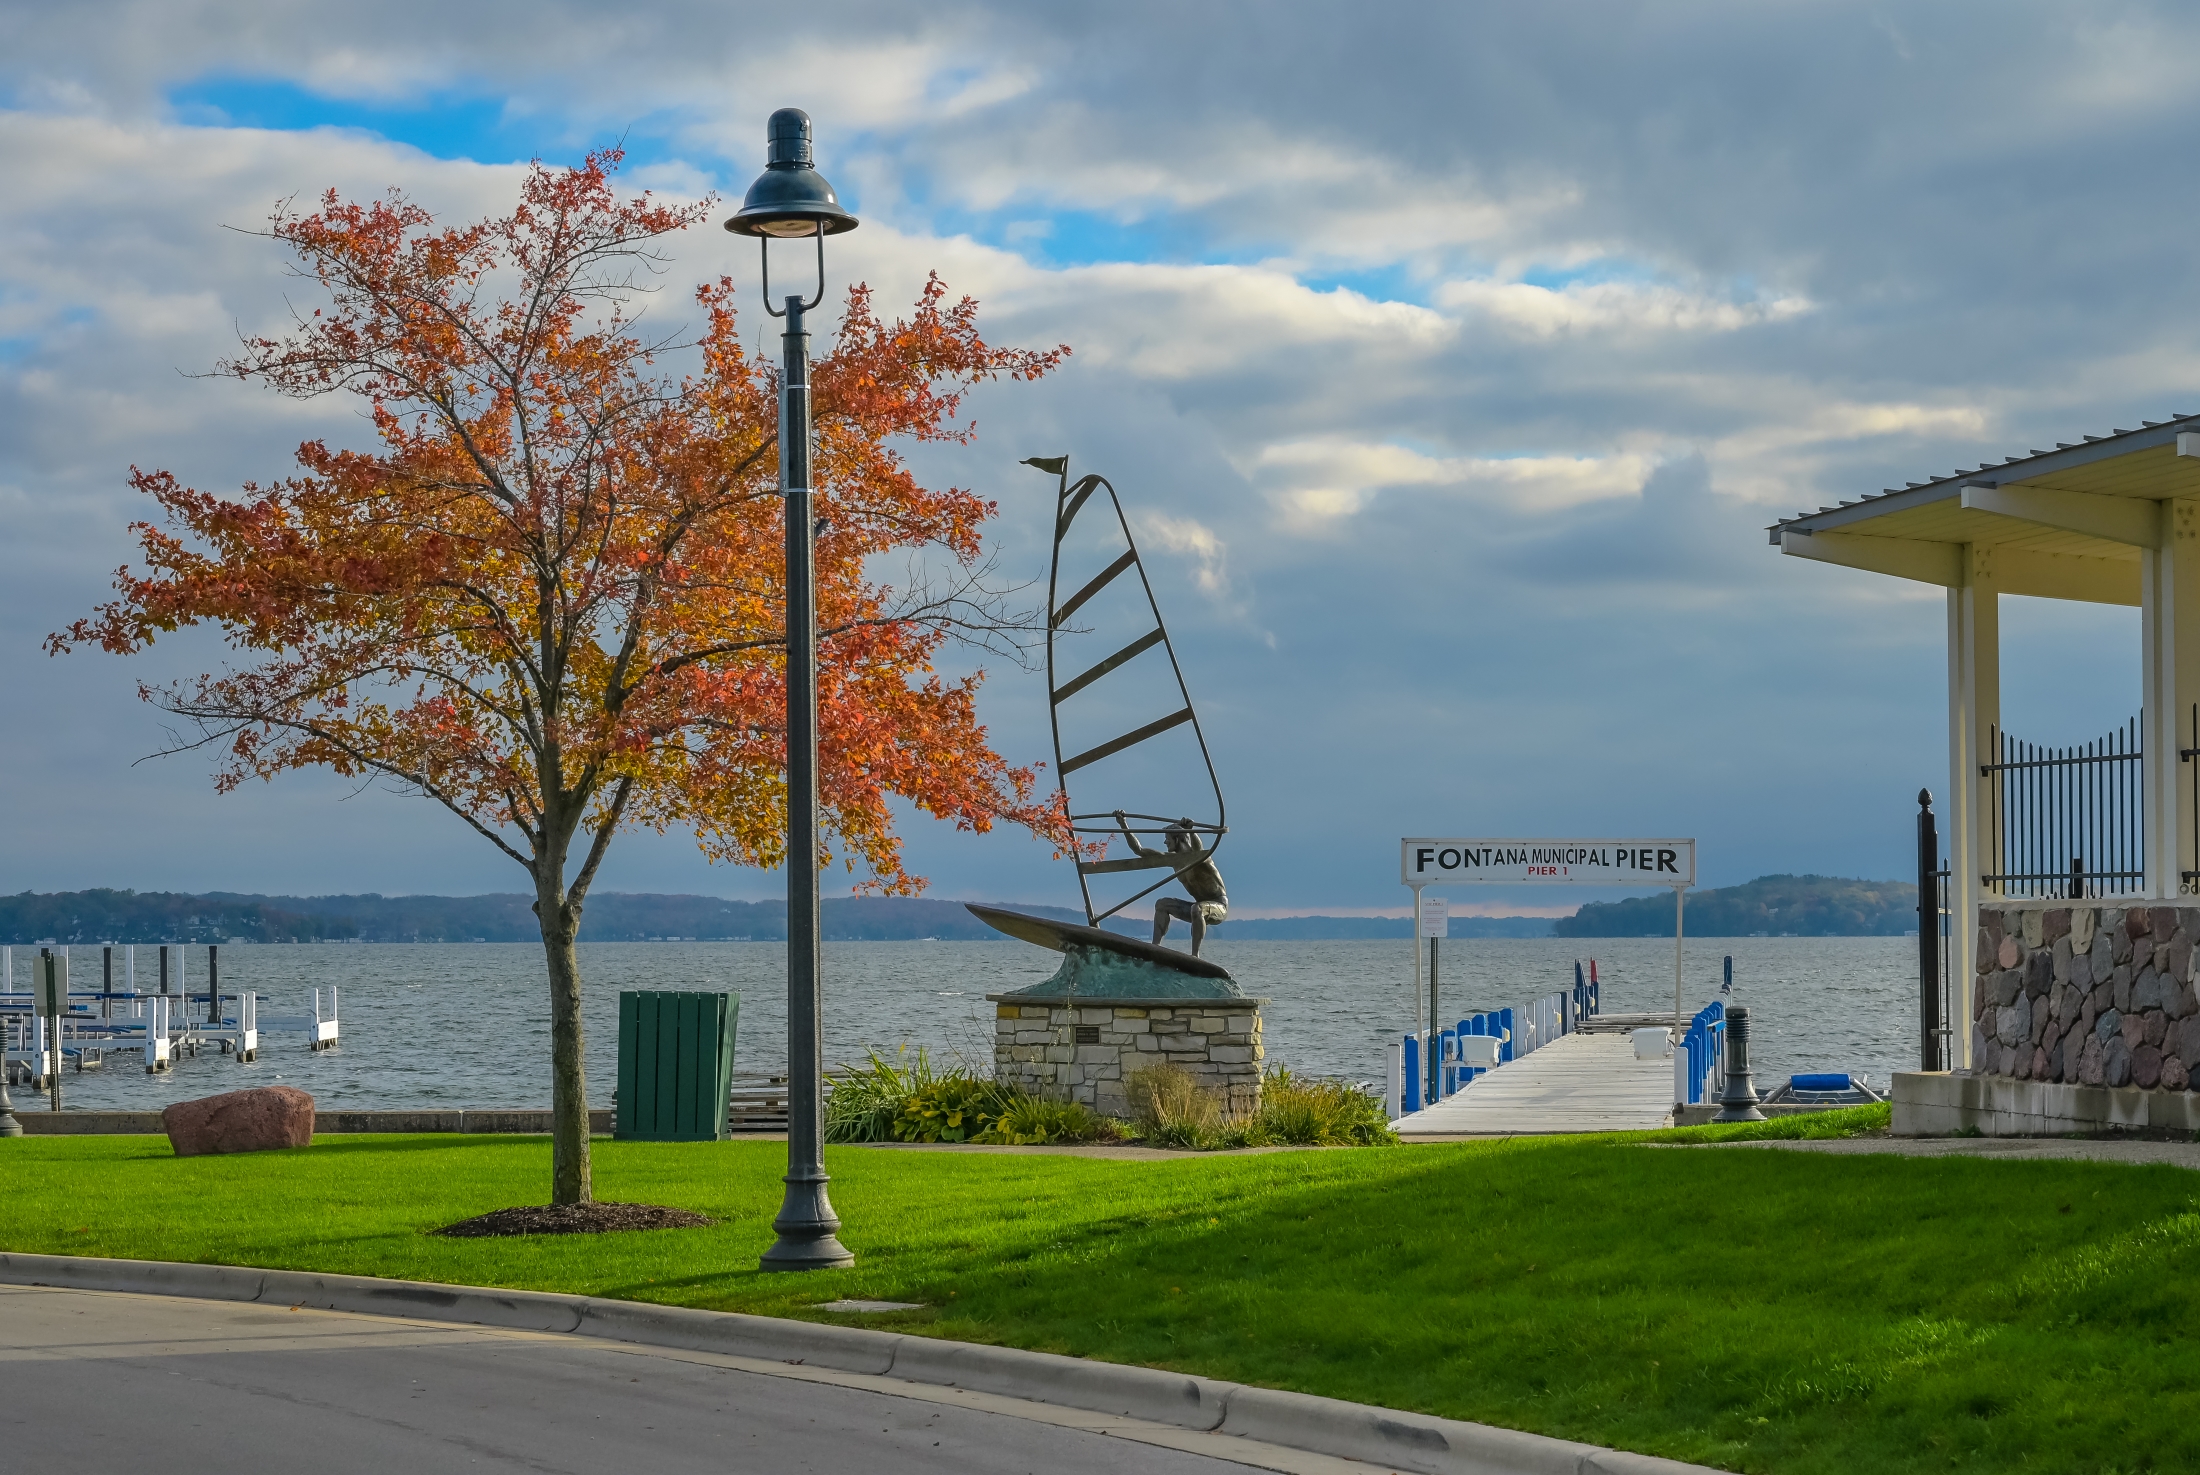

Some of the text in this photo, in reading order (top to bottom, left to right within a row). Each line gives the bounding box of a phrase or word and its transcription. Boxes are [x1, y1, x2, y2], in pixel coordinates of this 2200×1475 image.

[1416, 848, 1680, 874] FONTANA MUNICIPAL PIER
[1528, 866, 1568, 876] PIER 1
